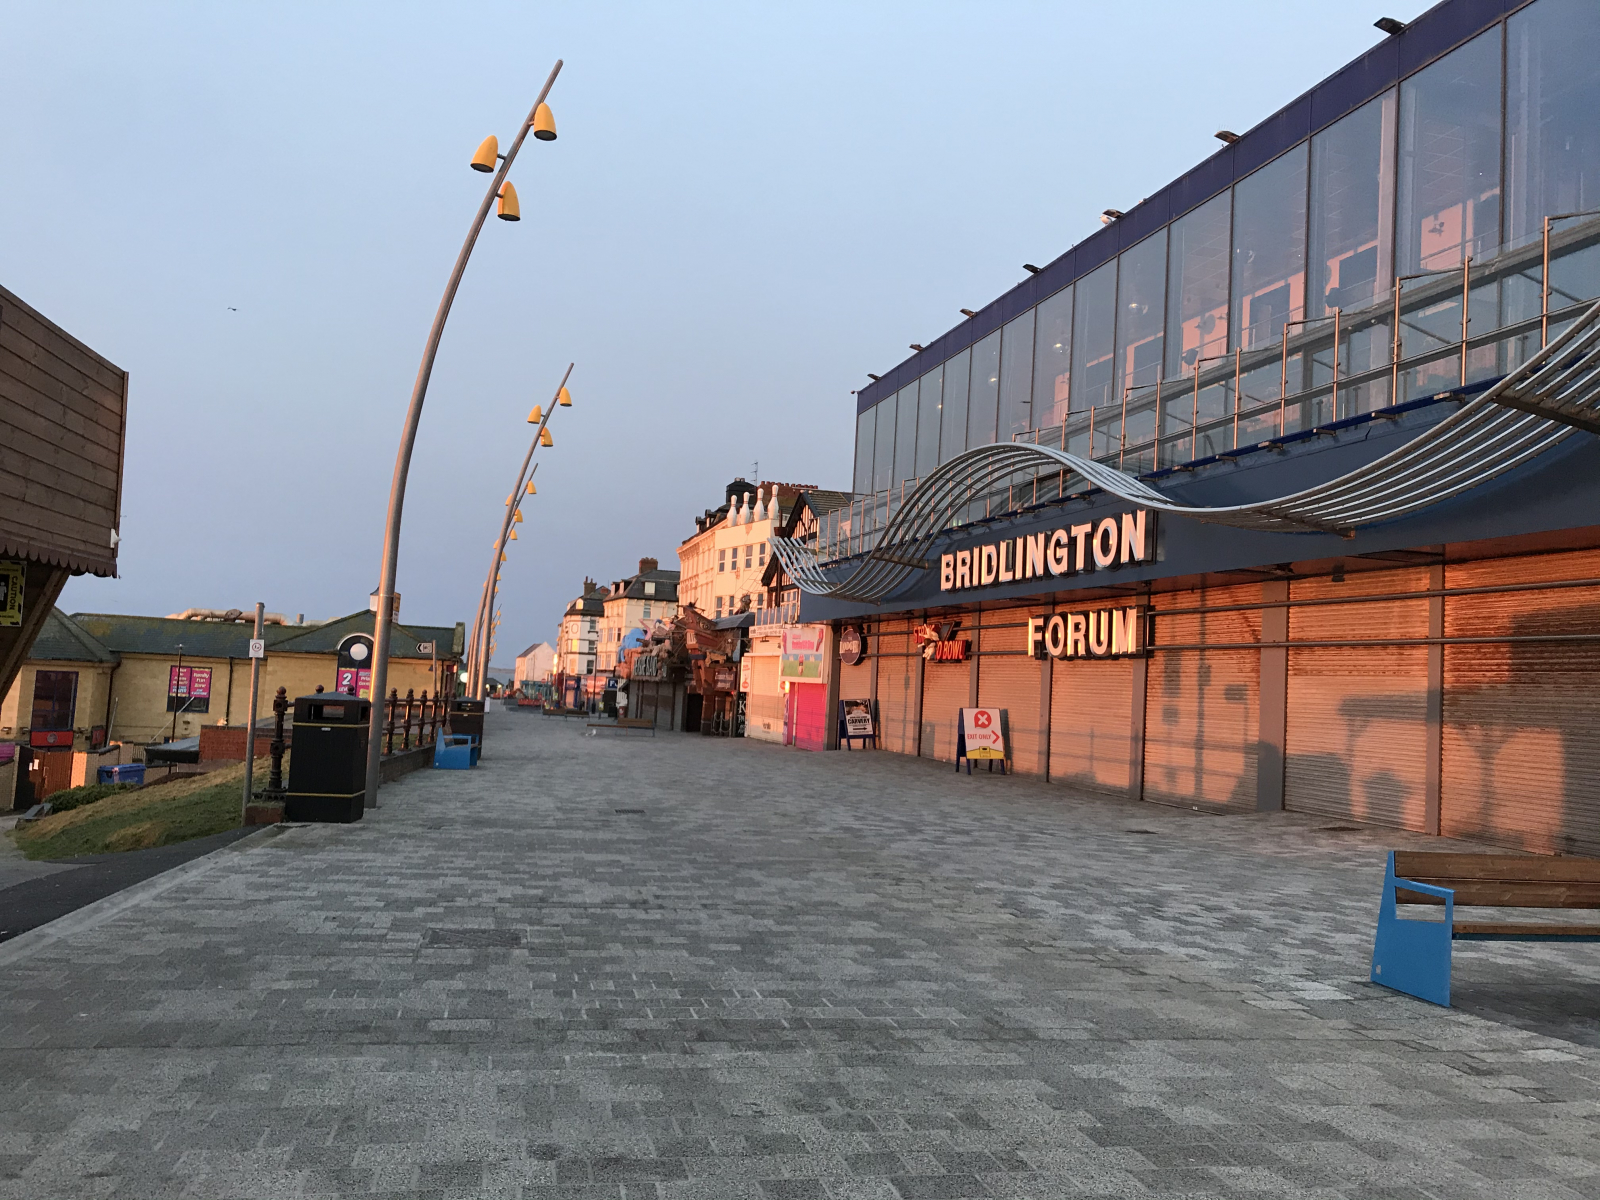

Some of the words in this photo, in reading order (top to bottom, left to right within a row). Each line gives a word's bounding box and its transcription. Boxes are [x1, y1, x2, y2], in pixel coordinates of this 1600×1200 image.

[941, 509, 1146, 592] BRIDLINGTON
[9, 575, 18, 611] CAUTION
[1028, 606, 1137, 658] FORUM
[341, 672, 353, 685] 2
